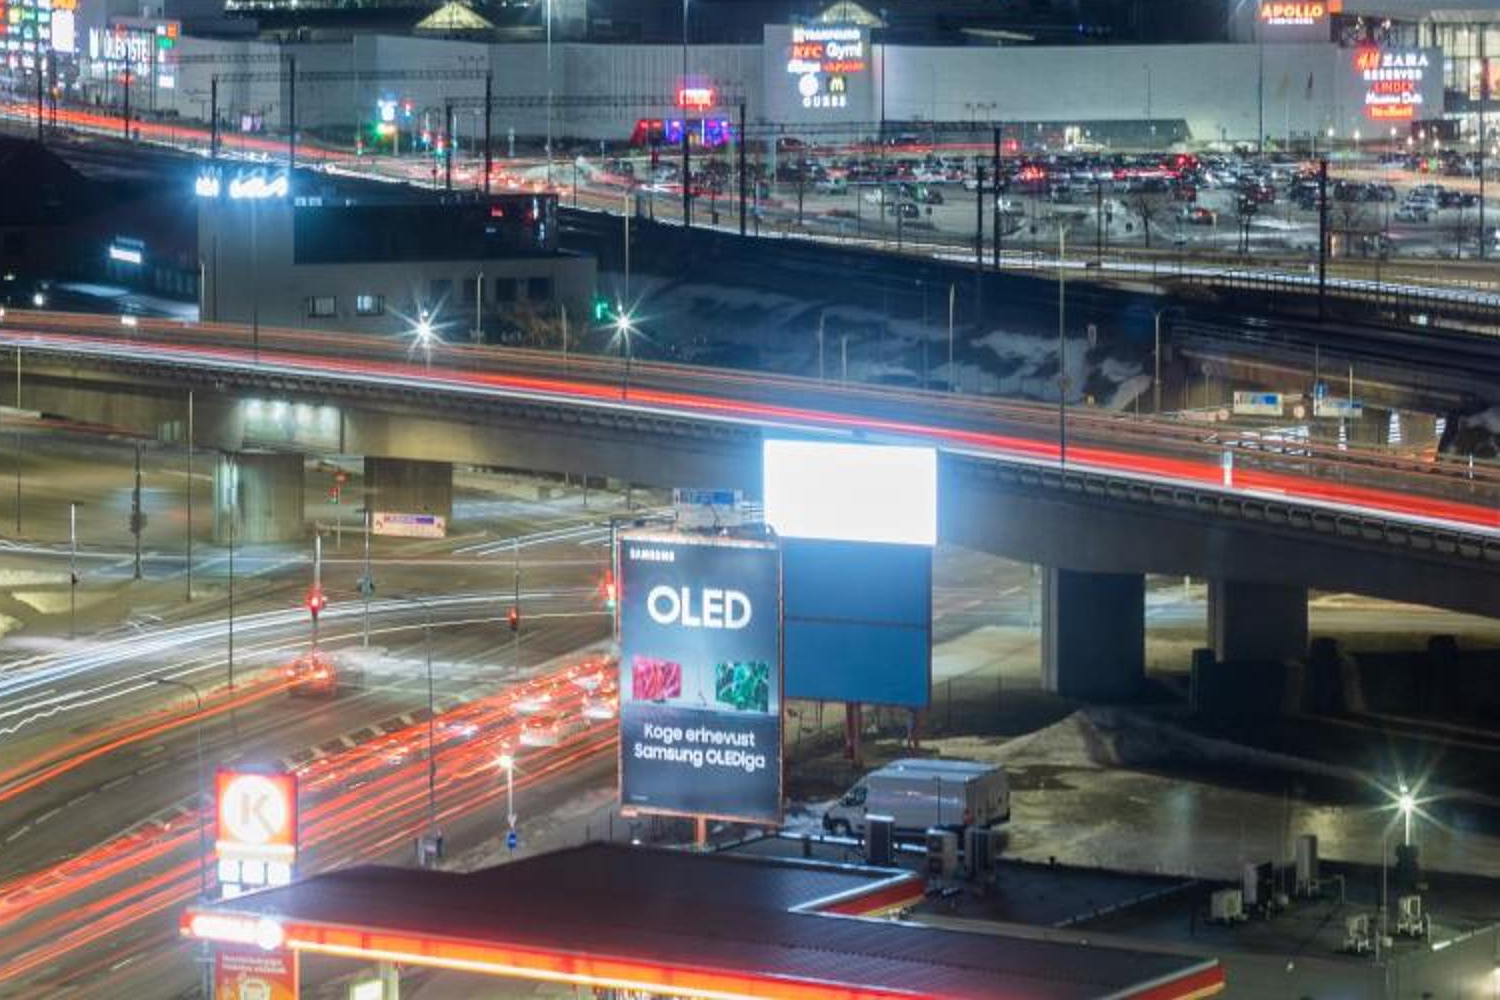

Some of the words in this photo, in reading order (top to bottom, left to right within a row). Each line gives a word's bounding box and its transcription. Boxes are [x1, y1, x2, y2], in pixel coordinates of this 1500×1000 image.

[1261, 2, 1323, 17] APOLLO
[1382, 53, 1428, 67] ZARA
[647, 585, 753, 629] OLED
[644, 722, 683, 744] Koge
[685, 724, 755, 747] erinevust
[633, 743, 703, 768] Samsung
[241, 791, 276, 836] K
